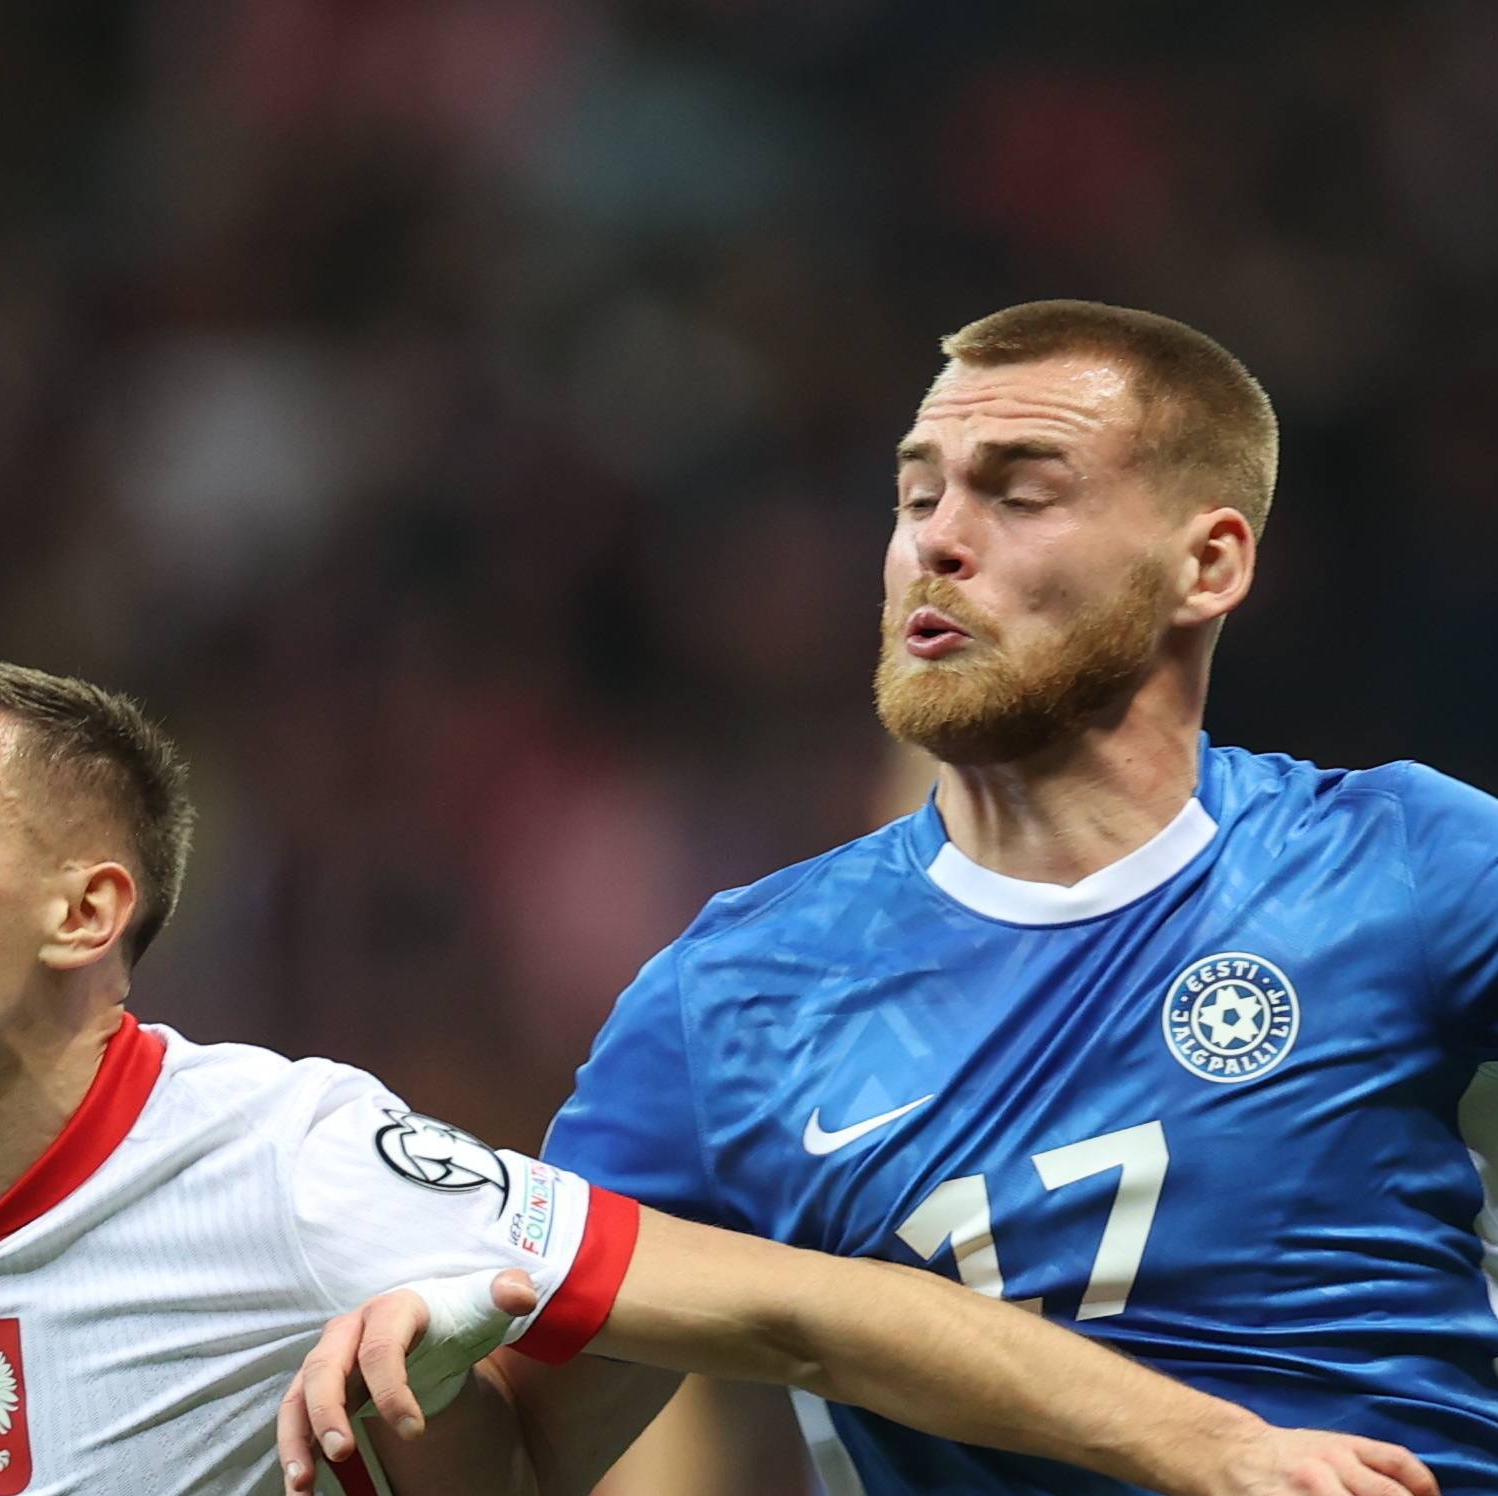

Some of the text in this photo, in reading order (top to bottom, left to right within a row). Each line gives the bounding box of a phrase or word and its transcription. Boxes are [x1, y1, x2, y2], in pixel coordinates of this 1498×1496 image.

[1186, 960, 1260, 993] EESTI
[1170, 988, 1292, 1075] JALGPALLI LIIT
[895, 1120, 1170, 1322] 17
